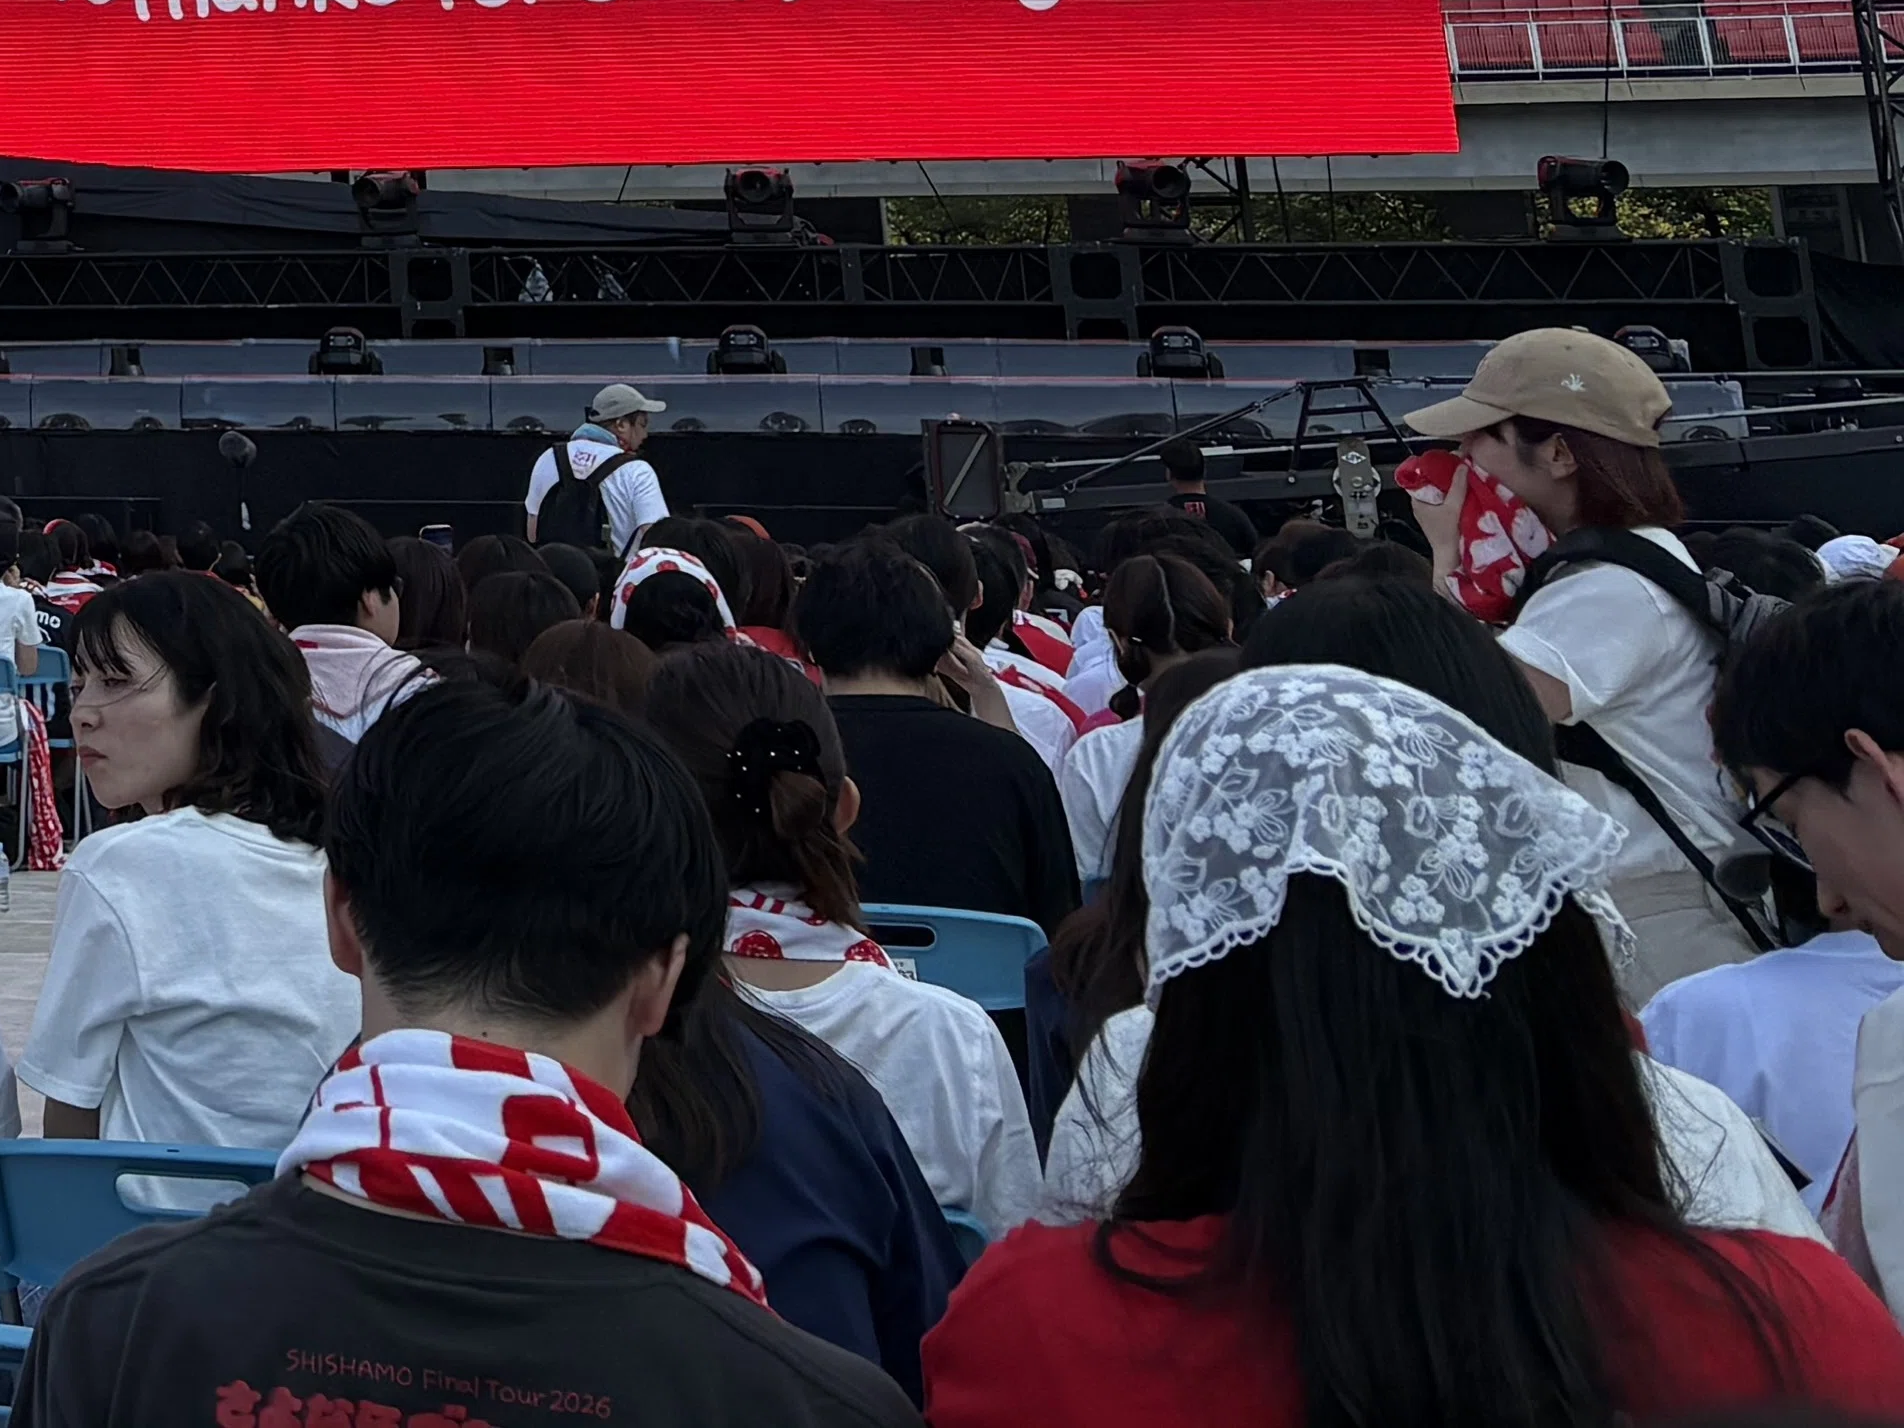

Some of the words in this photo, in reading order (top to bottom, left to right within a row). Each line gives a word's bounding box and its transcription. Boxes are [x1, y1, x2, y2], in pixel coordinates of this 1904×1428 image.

[285, 1348, 413, 1388] SHISHAMO
[422, 1370, 480, 1399] Final
[489, 1379, 546, 1408] Tour
[548, 1389, 612, 1420] 2026
